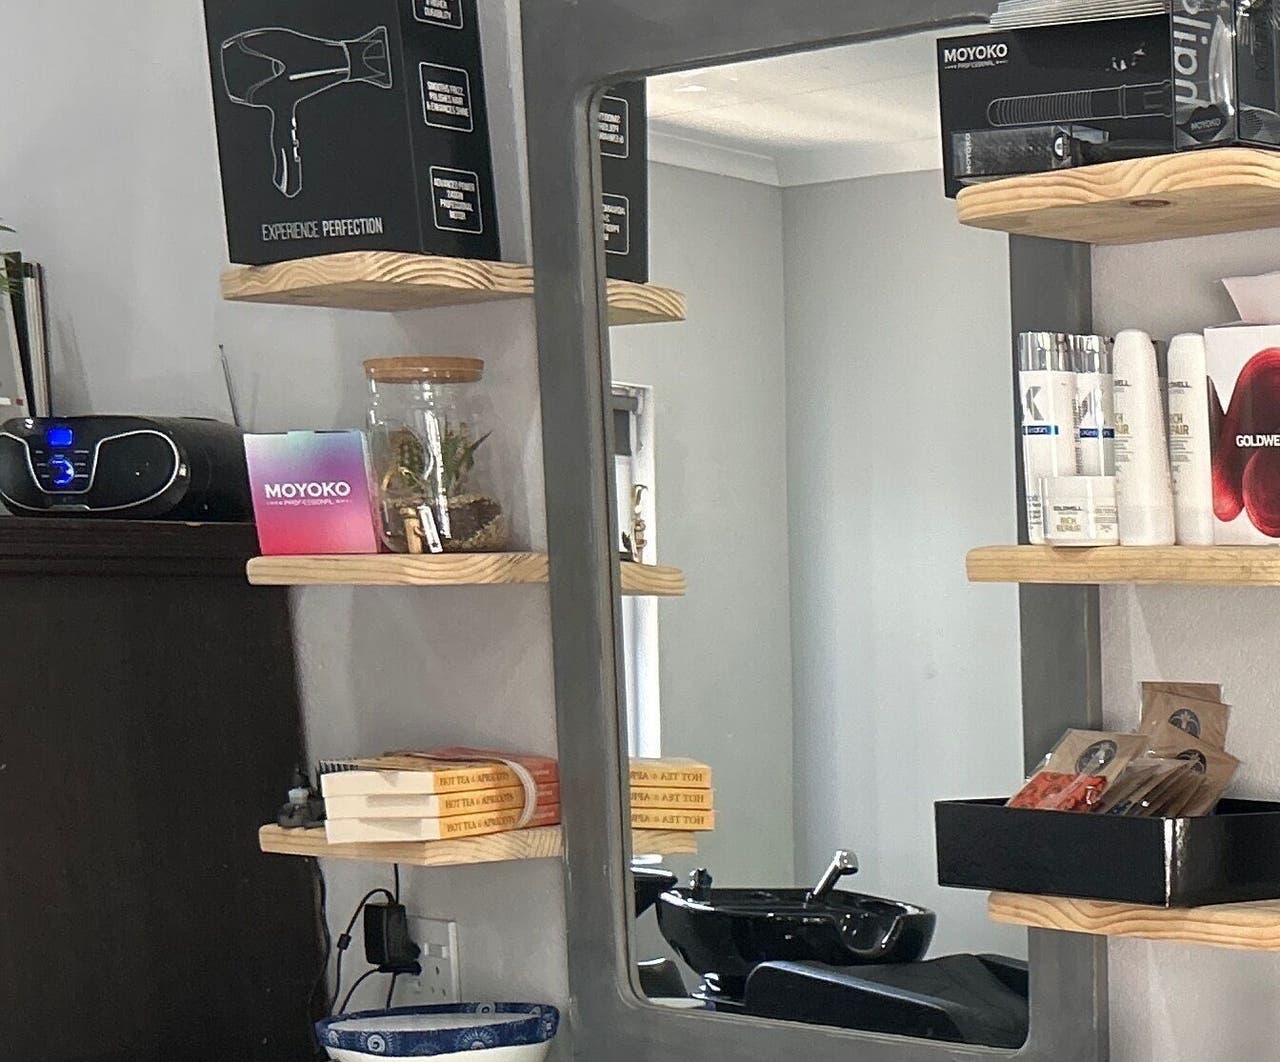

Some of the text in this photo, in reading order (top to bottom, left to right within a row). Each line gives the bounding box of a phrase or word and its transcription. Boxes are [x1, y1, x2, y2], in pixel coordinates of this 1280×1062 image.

[944, 43, 1008, 63] MOYOKO
[261, 217, 383, 241] EXPERIENCE PERFECTION
[264, 481, 351, 498] MOYOKO
[456, 775, 469, 785] TEA
[446, 799, 461, 809] HOT
[463, 797, 475, 807] TEA
[447, 823, 462, 833] HOT
[464, 821, 476, 831] TEA
